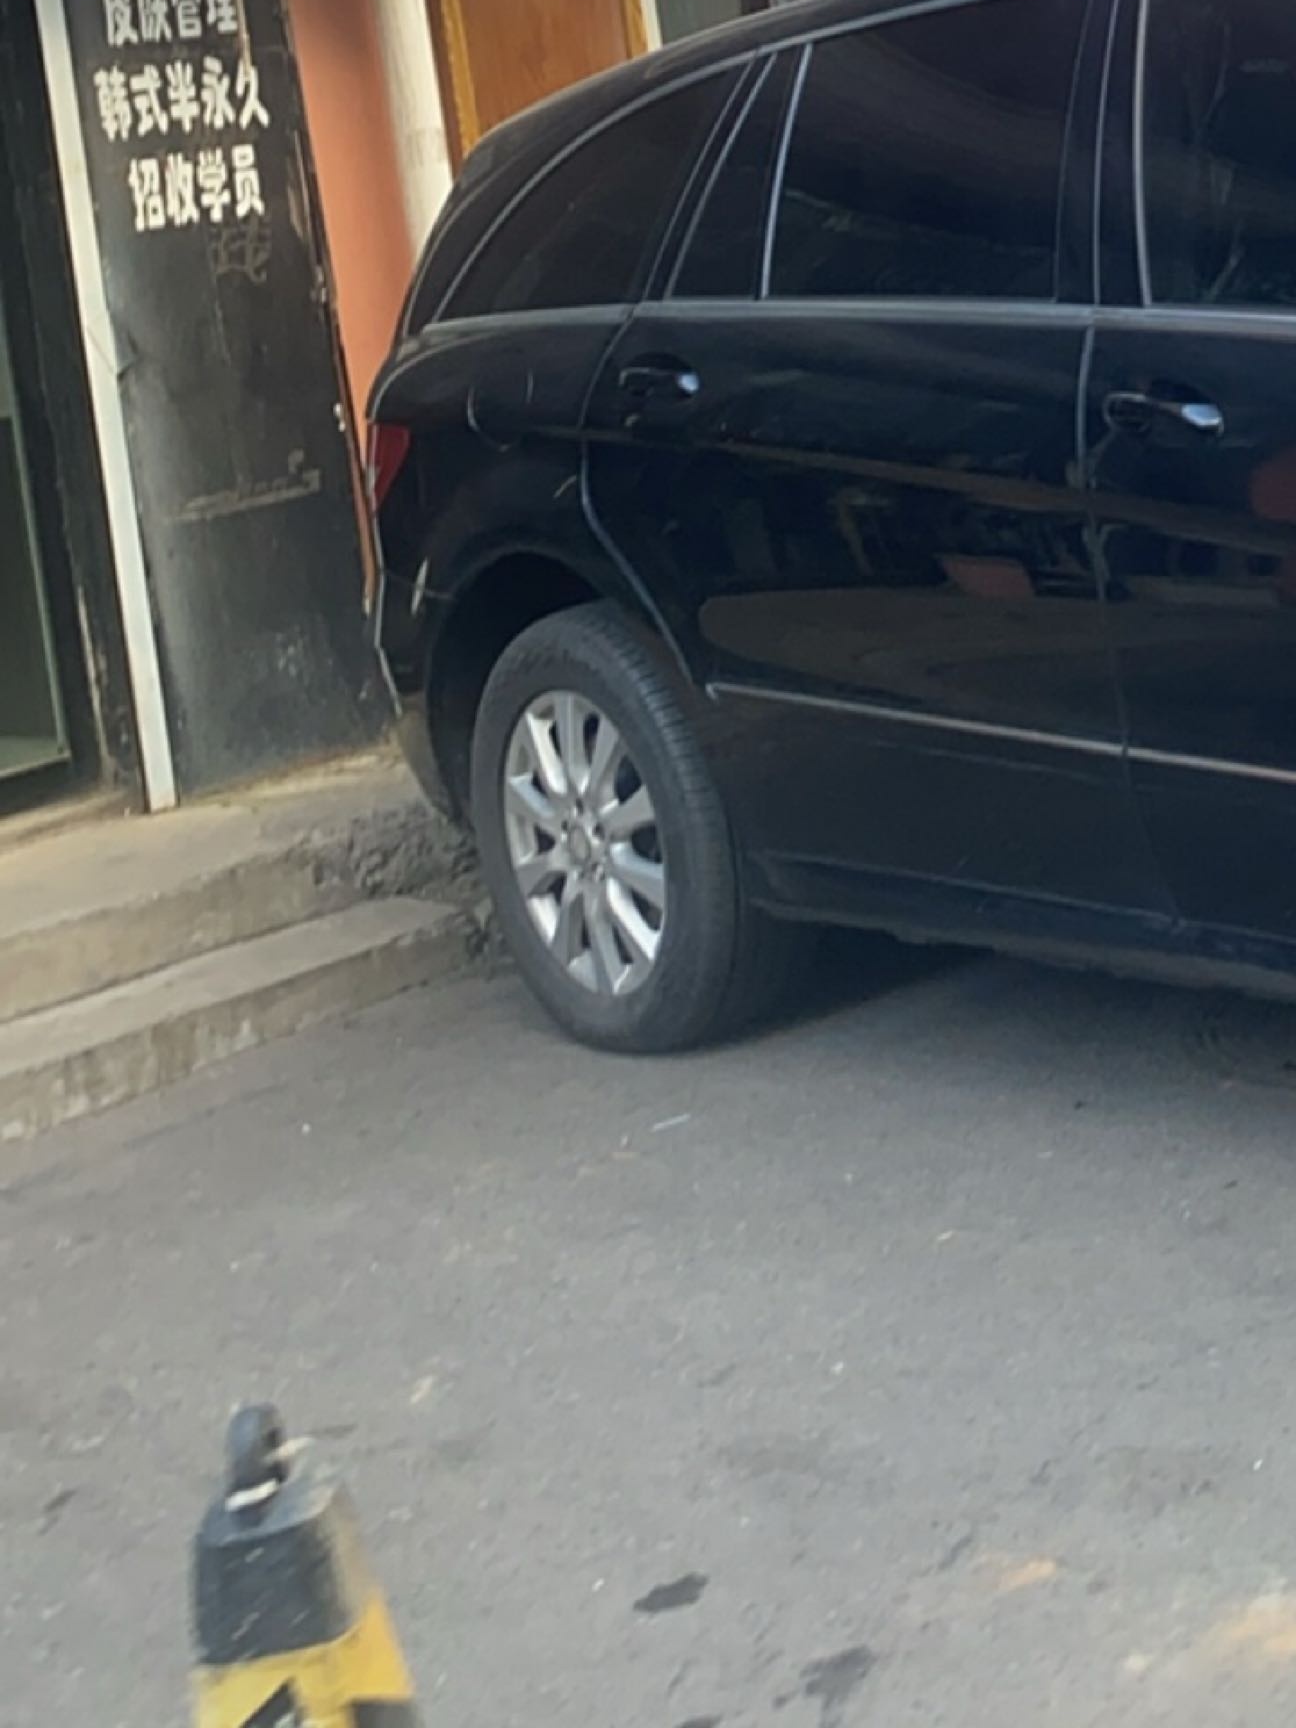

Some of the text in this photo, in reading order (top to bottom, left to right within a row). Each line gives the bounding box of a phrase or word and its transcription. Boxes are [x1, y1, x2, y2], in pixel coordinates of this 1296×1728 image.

[93, 56, 270, 142] 韩式半永久
[128, 144, 265, 233] 招收学员
